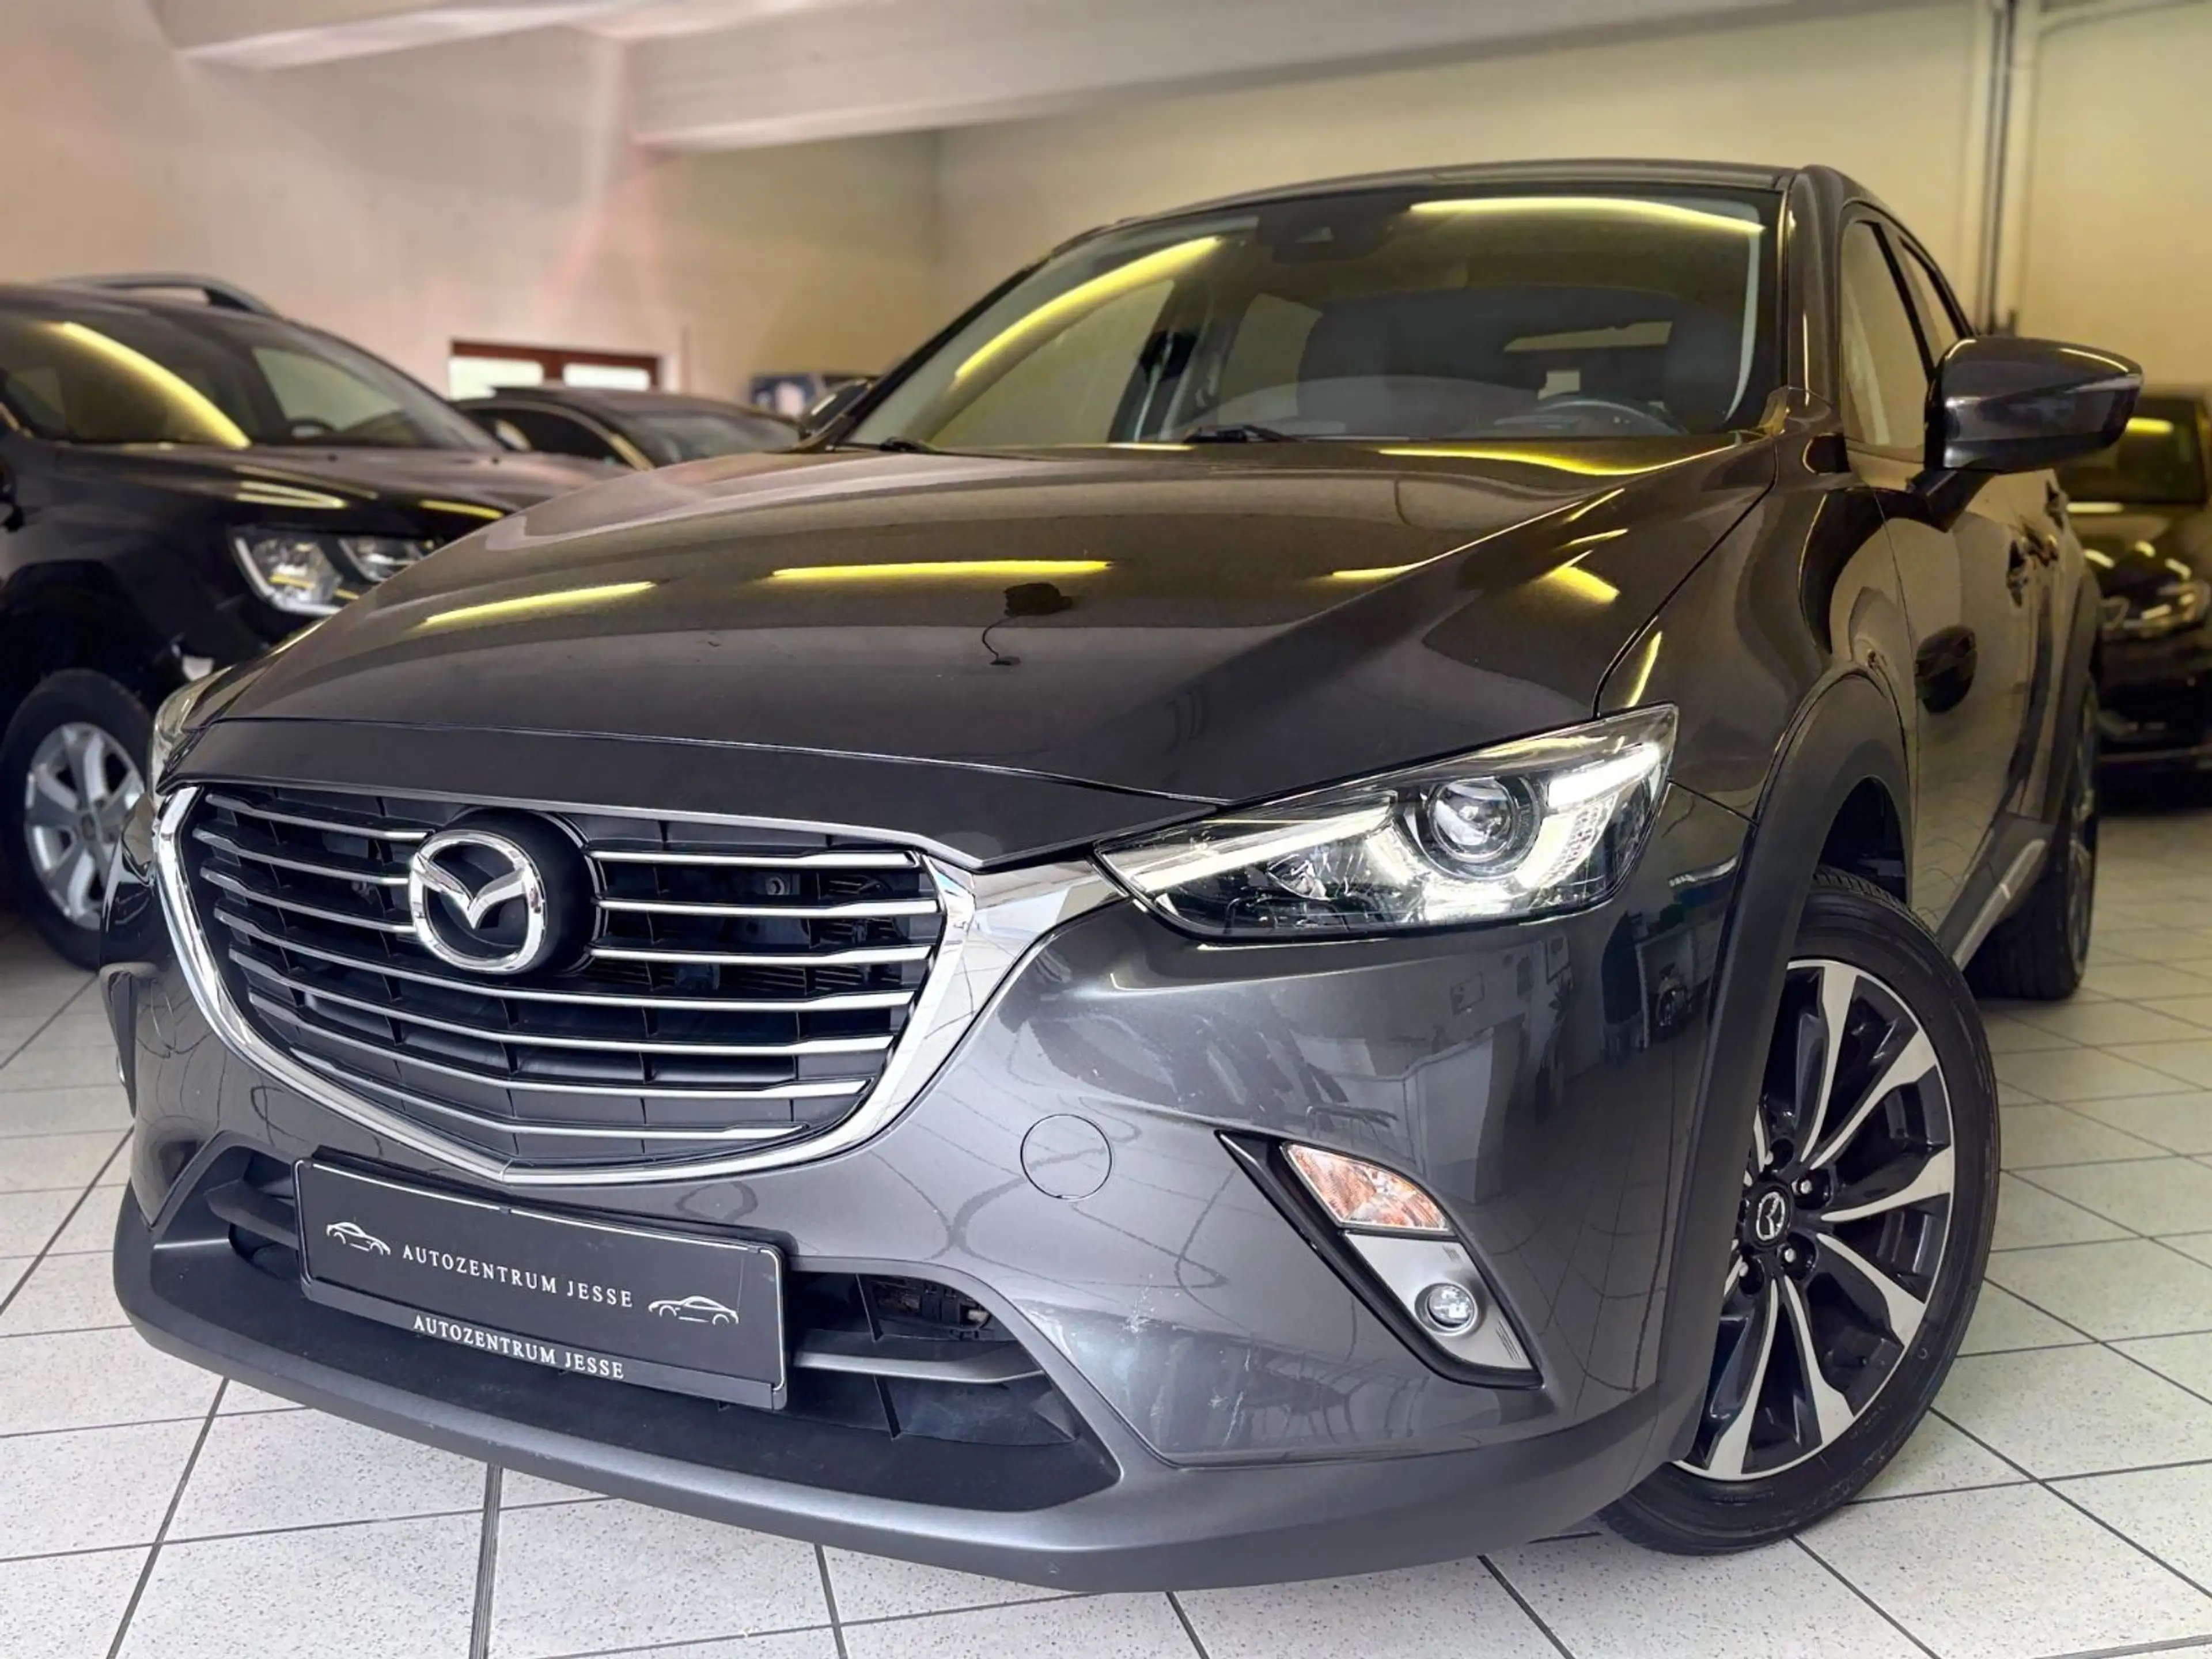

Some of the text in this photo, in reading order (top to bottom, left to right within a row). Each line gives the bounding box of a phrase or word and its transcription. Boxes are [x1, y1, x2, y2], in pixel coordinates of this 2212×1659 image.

[403, 1244, 632, 1308] AUTOZENTRUM JESSE
[413, 1315, 624, 1379] AUTOZENTRUM JESSE
